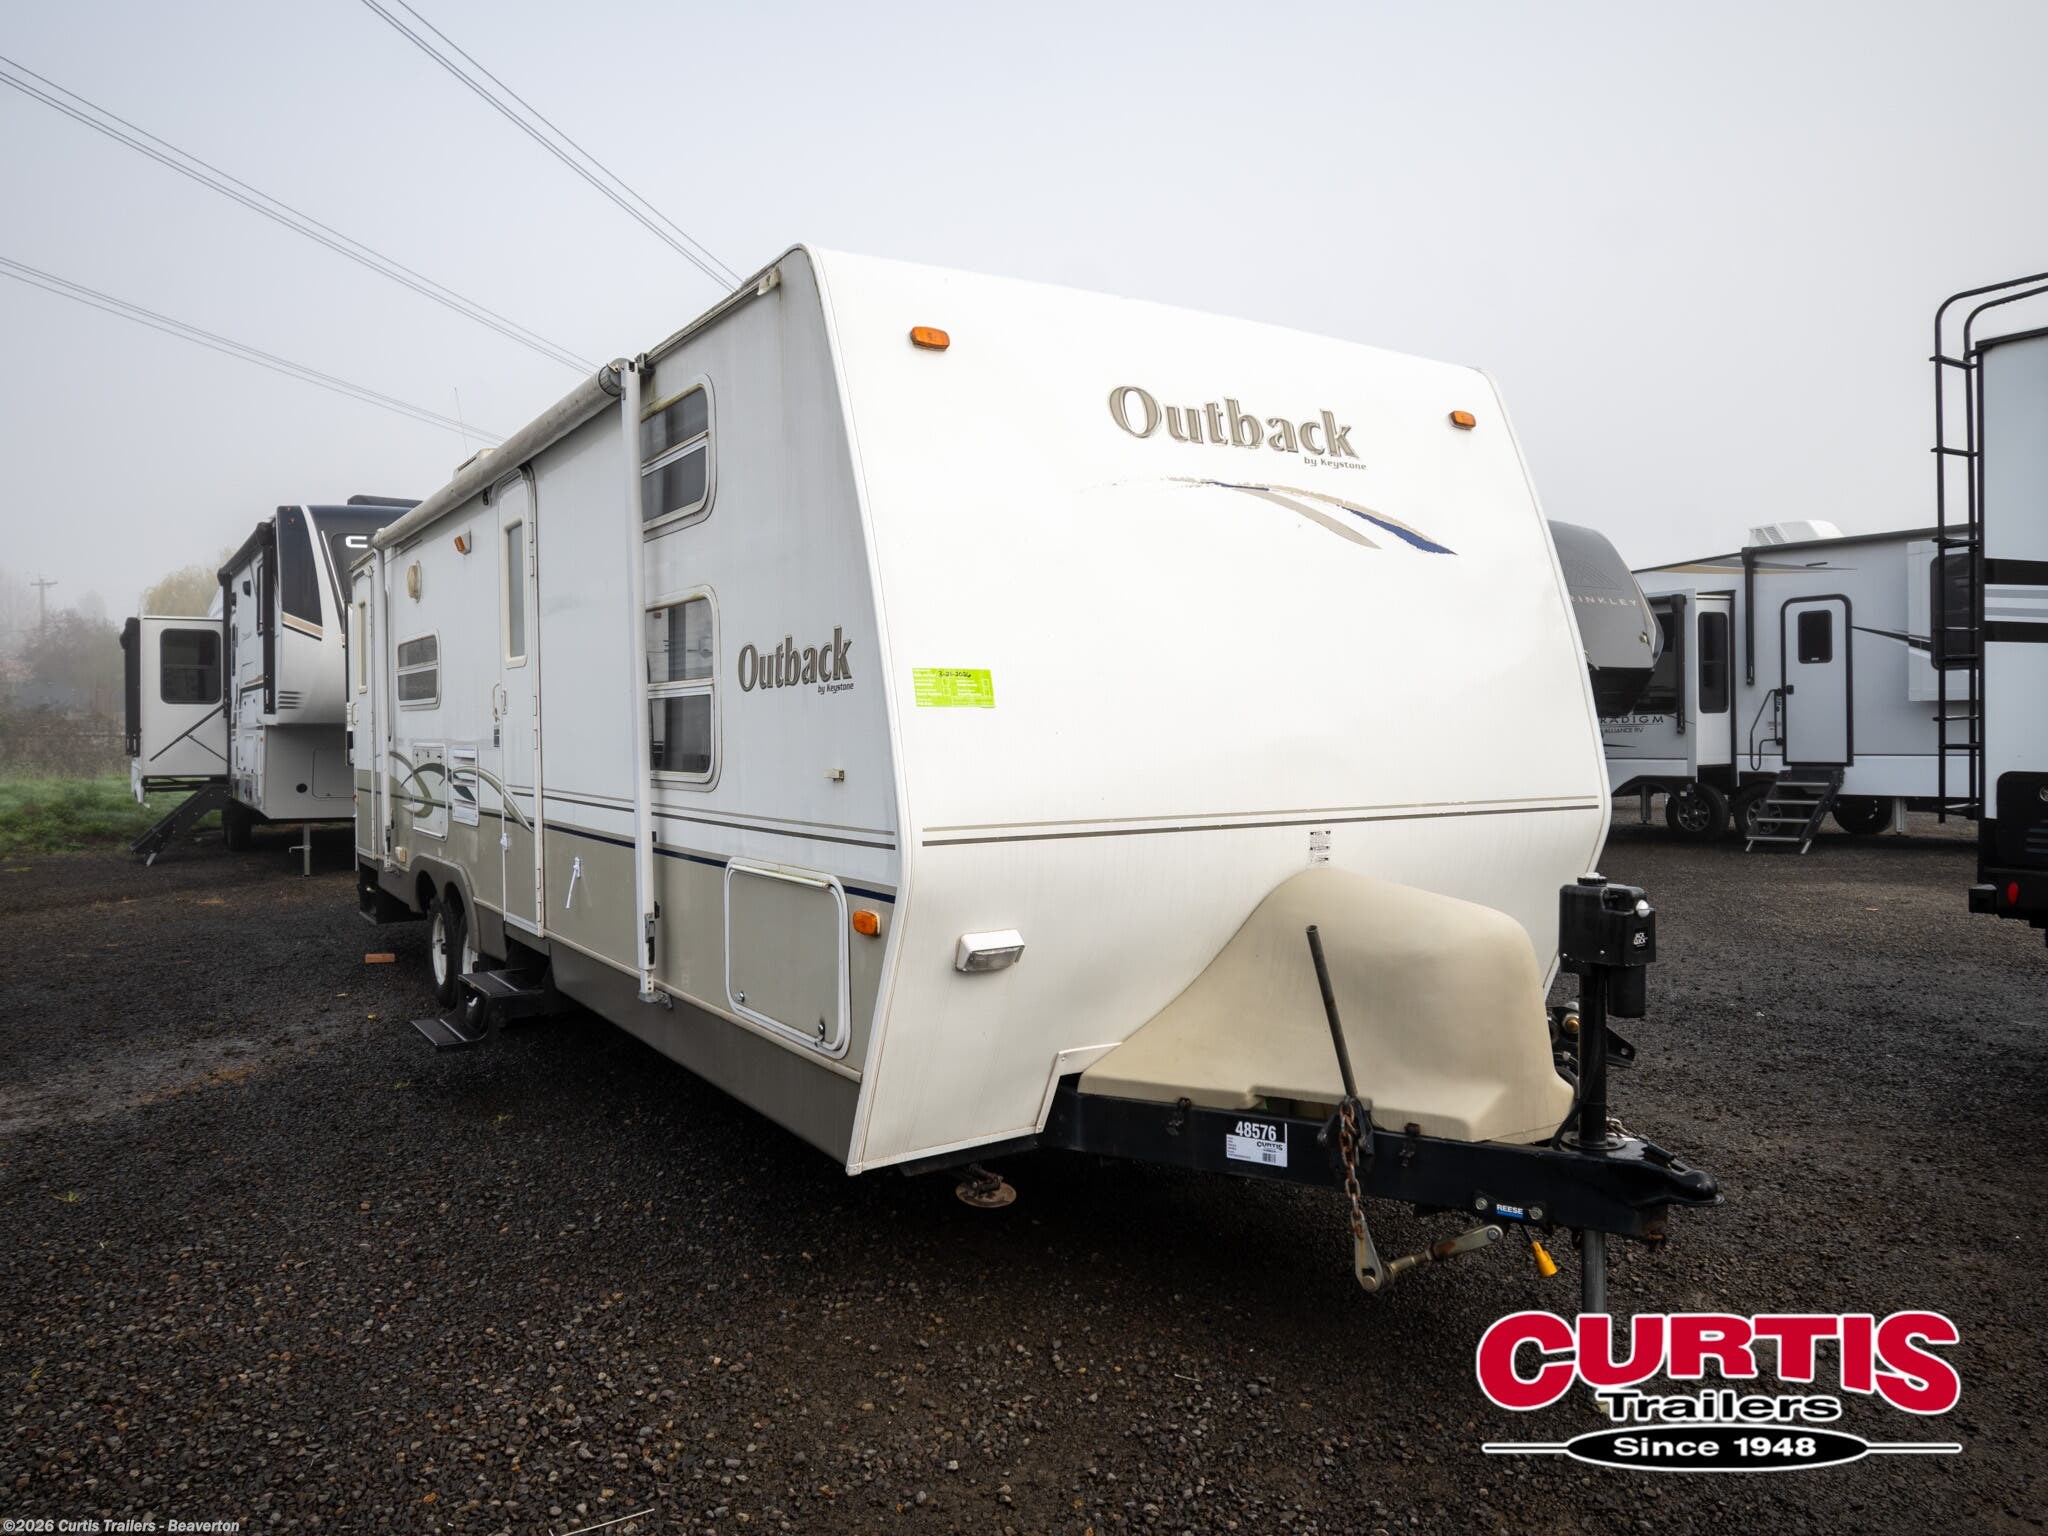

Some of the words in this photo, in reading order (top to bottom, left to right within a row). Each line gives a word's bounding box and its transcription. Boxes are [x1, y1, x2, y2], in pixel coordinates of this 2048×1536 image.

[1107, 385, 1360, 459] Outback
[1304, 456, 1317, 467] by
[1320, 458, 1367, 470] Keystone
[737, 624, 853, 692] Outback
[817, 684, 826, 695] by
[826, 682, 855, 694] Keystone
[1235, 1120, 1277, 1142] 48576
[1496, 1203, 1524, 1215] REESE
